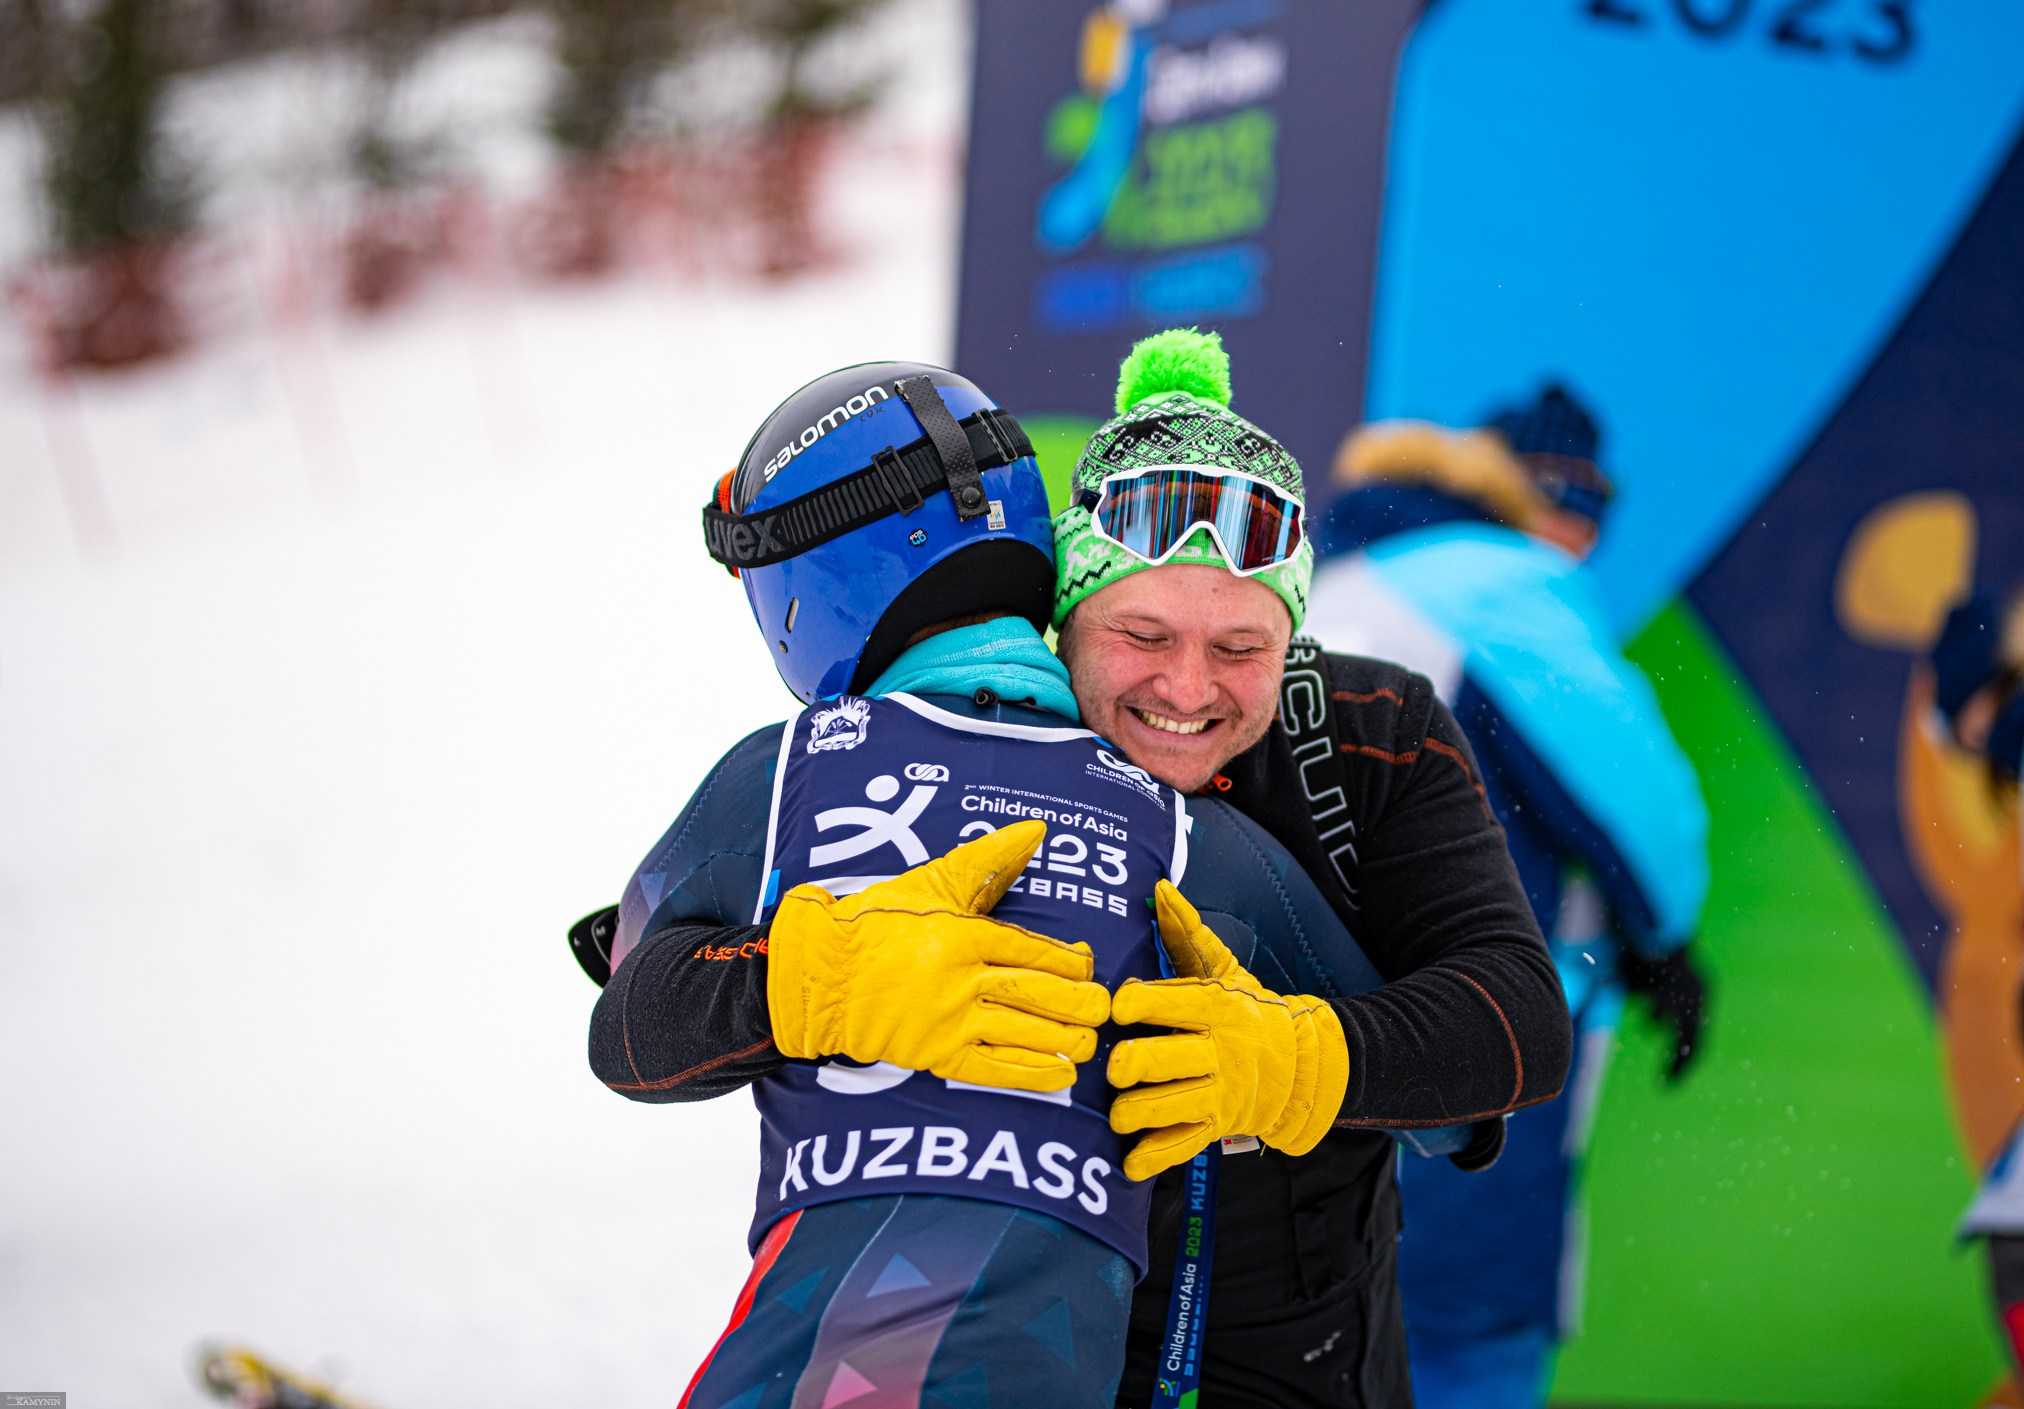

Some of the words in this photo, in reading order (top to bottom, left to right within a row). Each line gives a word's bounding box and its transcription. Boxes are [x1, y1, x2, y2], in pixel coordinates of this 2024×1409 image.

[705, 514, 785, 560] uvex
[1085, 770, 1135, 791] INTERNATIONAL
[1086, 764, 1133, 785] CHILDREN
[961, 795, 1057, 822] Children
[1059, 813, 1082, 827] of
[1082, 816, 1128, 842] Asia
[978, 785, 1011, 794] WINTER
[1011, 789, 1073, 806] INTERNATIONAL
[1074, 801, 1102, 814] SPORTS
[1103, 810, 1128, 823] GAMES
[957, 821, 1128, 886] 23
[779, 1126, 1111, 1215] KUZBASS
[1190, 1148, 1208, 1210] KUZB
[1185, 1216, 1203, 1257] 2023
[1180, 1264, 1197, 1295] Asia
[1179, 1295, 1192, 1311] of
[1167, 1313, 1189, 1371] Children
